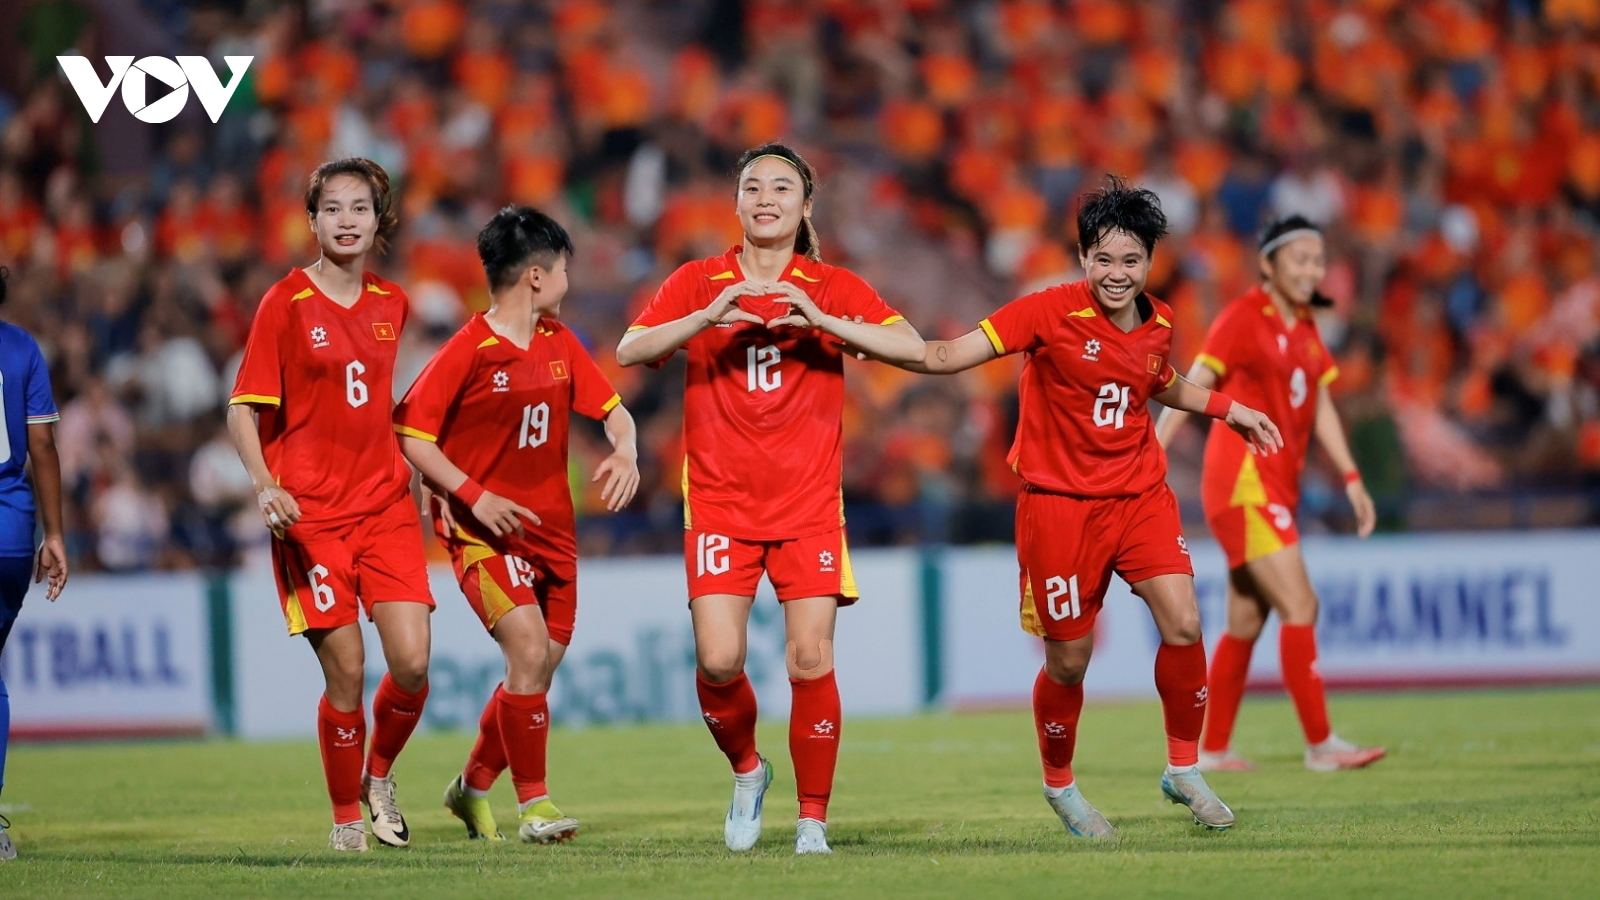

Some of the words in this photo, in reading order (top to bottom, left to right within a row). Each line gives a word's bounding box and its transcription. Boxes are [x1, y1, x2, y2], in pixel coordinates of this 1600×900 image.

[345, 359, 369, 409] 6
[747, 344, 782, 393] 12
[1289, 365, 1308, 410] 9
[518, 401, 550, 450] 19
[1092, 381, 1131, 430] 21
[696, 532, 731, 578] 12
[307, 563, 336, 614] 6
[1045, 574, 1082, 621] 21
[1314, 570, 1570, 646] HANNEL
[0, 620, 184, 688] TBALL
